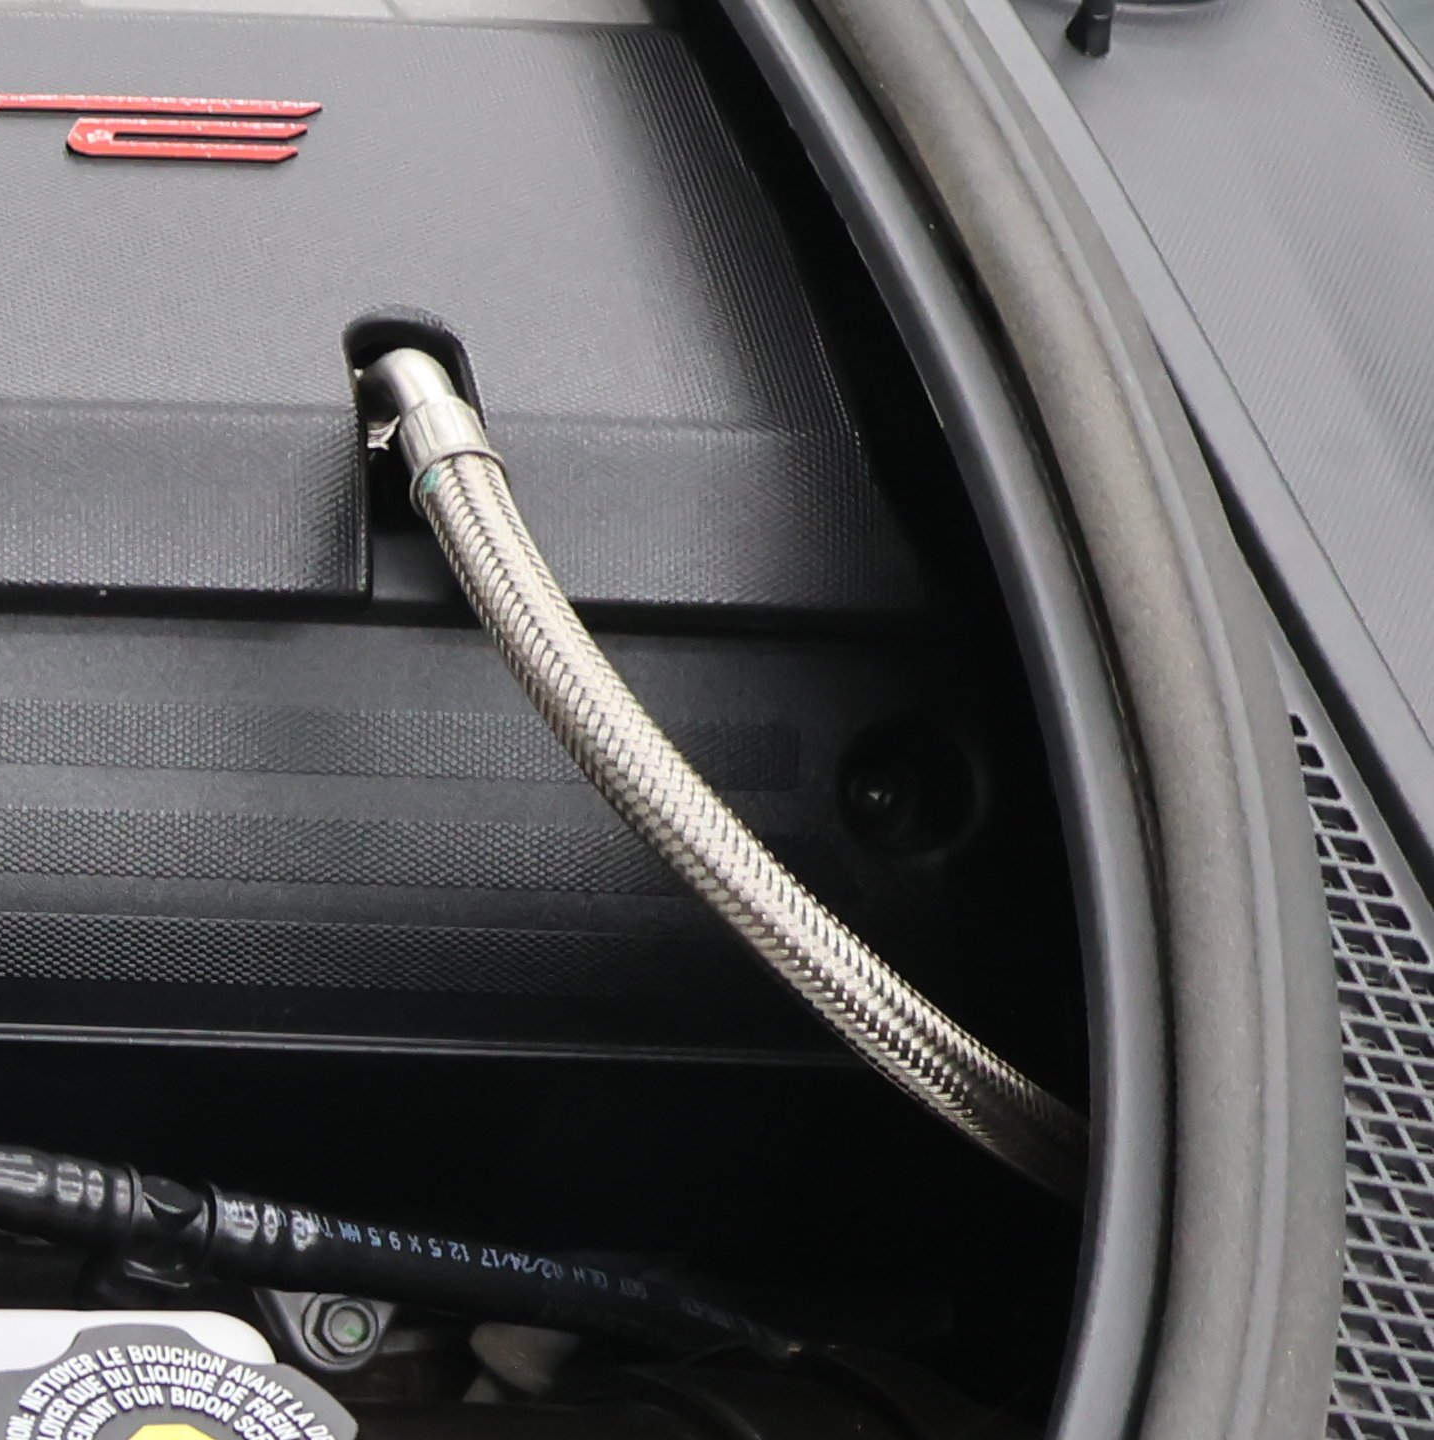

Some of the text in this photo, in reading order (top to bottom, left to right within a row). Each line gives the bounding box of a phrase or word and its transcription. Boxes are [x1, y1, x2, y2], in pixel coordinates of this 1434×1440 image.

[19, 1353, 100, 1413] NETTOYER
[96, 1347, 126, 1368] LE
[127, 1345, 227, 1376] BOUCHON
[226, 1364, 294, 1406] AVANT
[284, 1401, 316, 1427] LA
[64, 1375, 107, 1406] QUE
[102, 1367, 134, 1389] DU
[134, 1365, 217, 1394] LIQUIDE
[218, 1381, 249, 1406] DE
[114, 1386, 165, 1412] D'UN
[170, 1386, 237, 1423] BIDON
